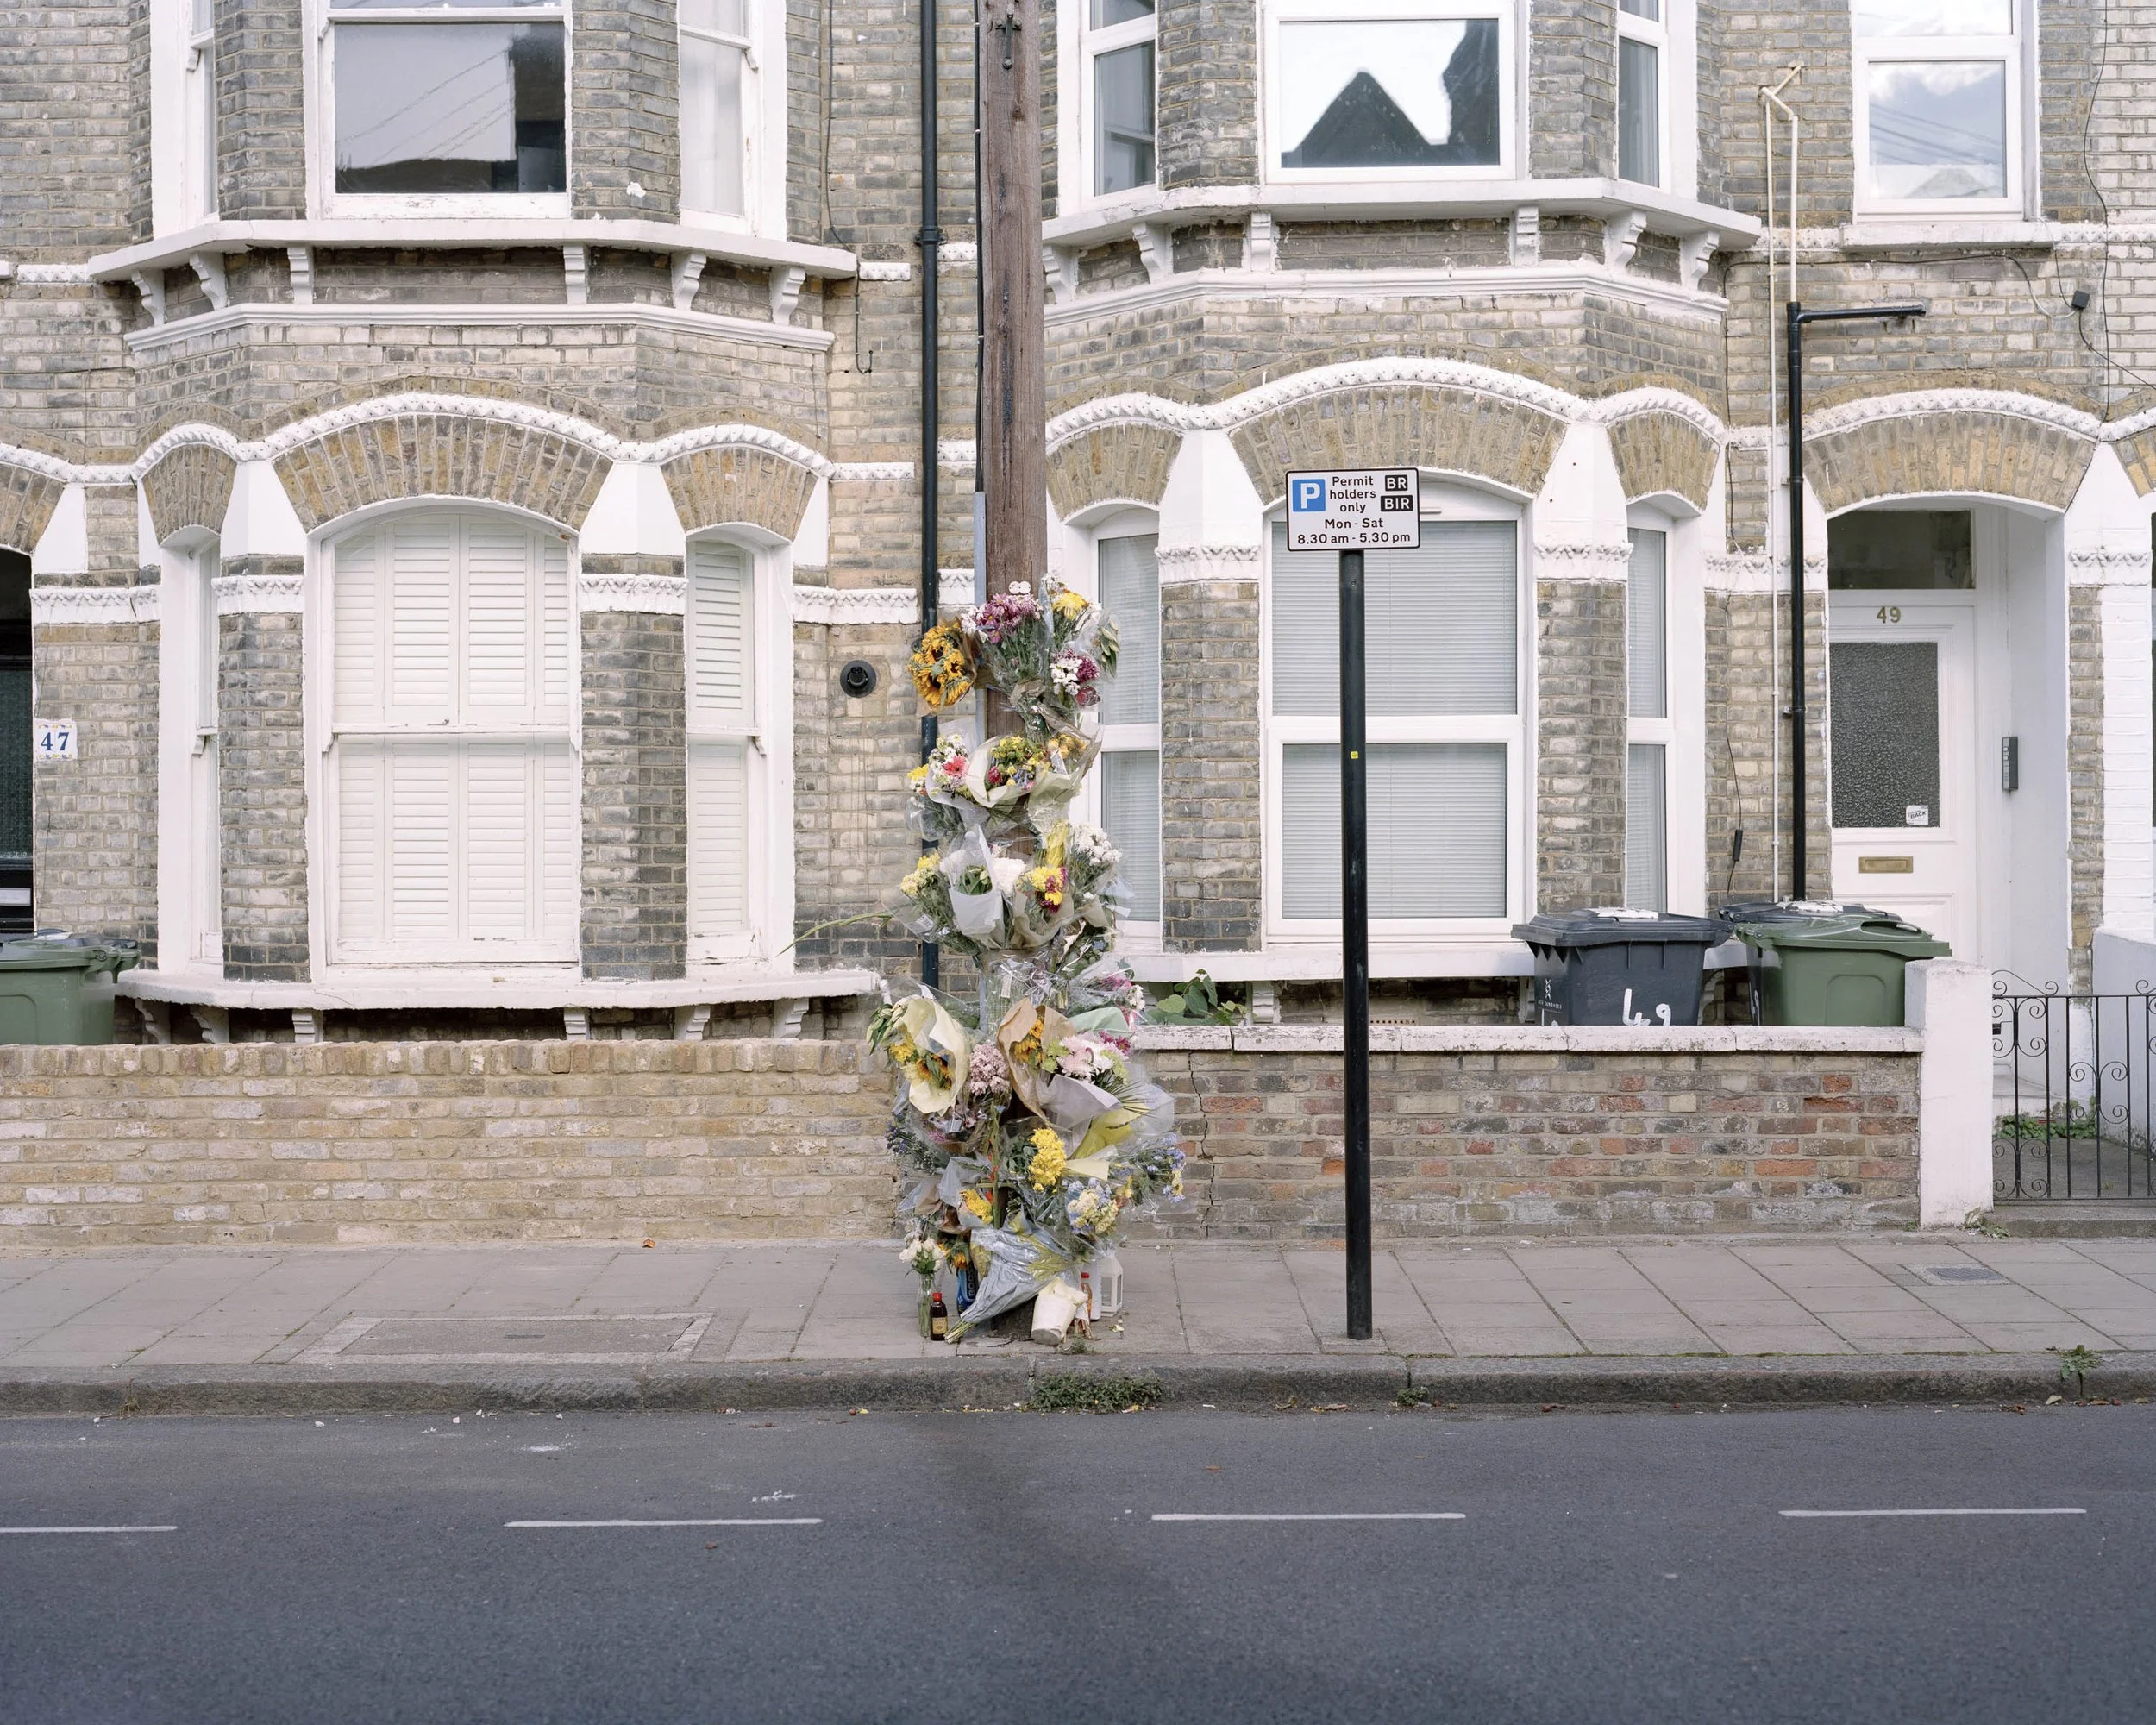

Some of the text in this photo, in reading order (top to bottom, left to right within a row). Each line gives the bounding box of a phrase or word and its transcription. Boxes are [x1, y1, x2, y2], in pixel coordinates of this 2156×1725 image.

[1332, 475, 1374, 486] Permit
[1387, 477, 1407, 489] BR
[1300, 482, 1320, 509] P
[1329, 489, 1376, 499] holders
[1339, 502, 1367, 513] only
[1384, 498, 1410, 510] BIR
[1325, 519, 1351, 529] Mon
[1362, 518, 1384, 528] Sat
[1297, 533, 1327, 544] 8.30
[1331, 535, 1349, 543] am
[1359, 532, 1389, 543] 5.30
[1392, 532, 1411, 544] pm
[1877, 606, 1902, 624] 49
[41, 731, 70, 750] 47
